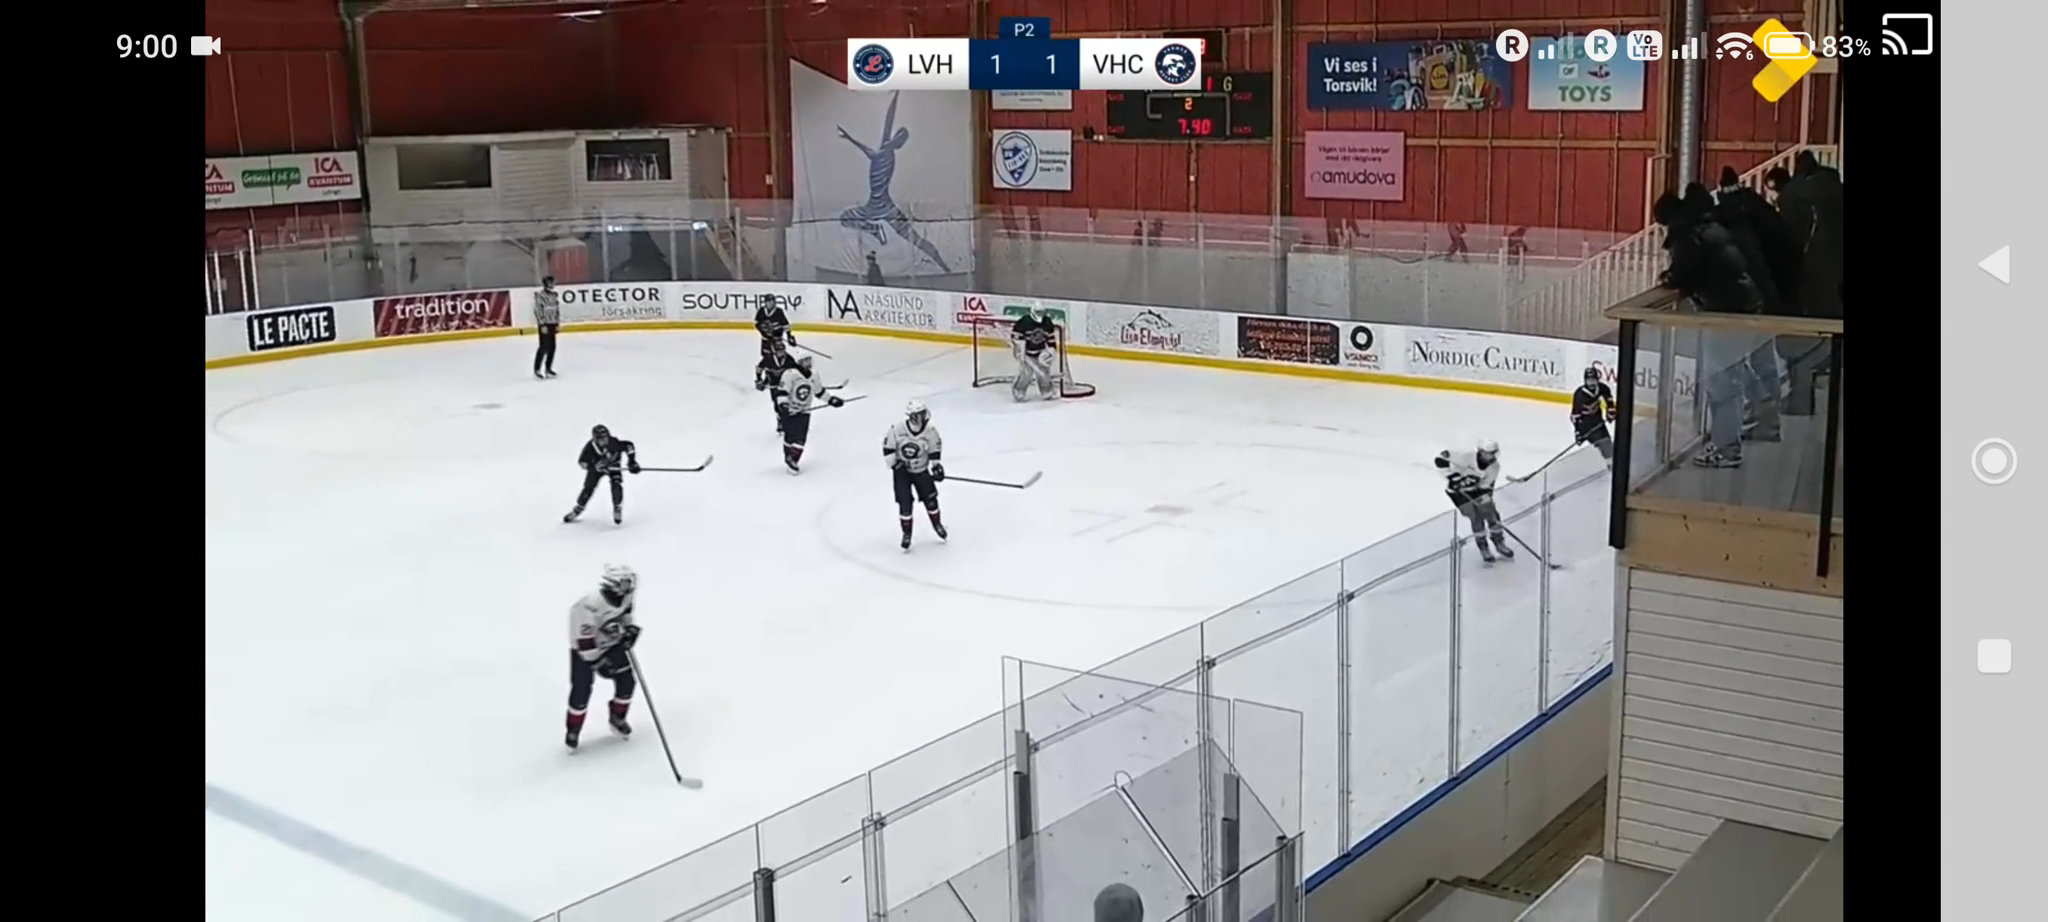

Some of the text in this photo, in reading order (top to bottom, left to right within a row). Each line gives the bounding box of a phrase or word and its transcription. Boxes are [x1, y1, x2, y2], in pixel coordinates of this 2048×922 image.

[1323, 56, 1378, 73] Vi ses i
[1223, 76, 1233, 92] G
[1323, 77, 1378, 92] Torsvik!
[1558, 85, 1612, 102] TOYS
[314, 157, 343, 174] ICA
[309, 176, 351, 186] KVANTUM
[1322, 169, 1396, 185] amudova
[206, 184, 233, 193] NTUM
[562, 287, 660, 304] OTECTOR
[963, 296, 987, 312] ICA
[394, 296, 491, 320] tradition
[253, 311, 330, 348] LE PACTE
[1411, 340, 1560, 377] NORDIC CAPITAL
[1591, 360, 1696, 397] Swdbnk
